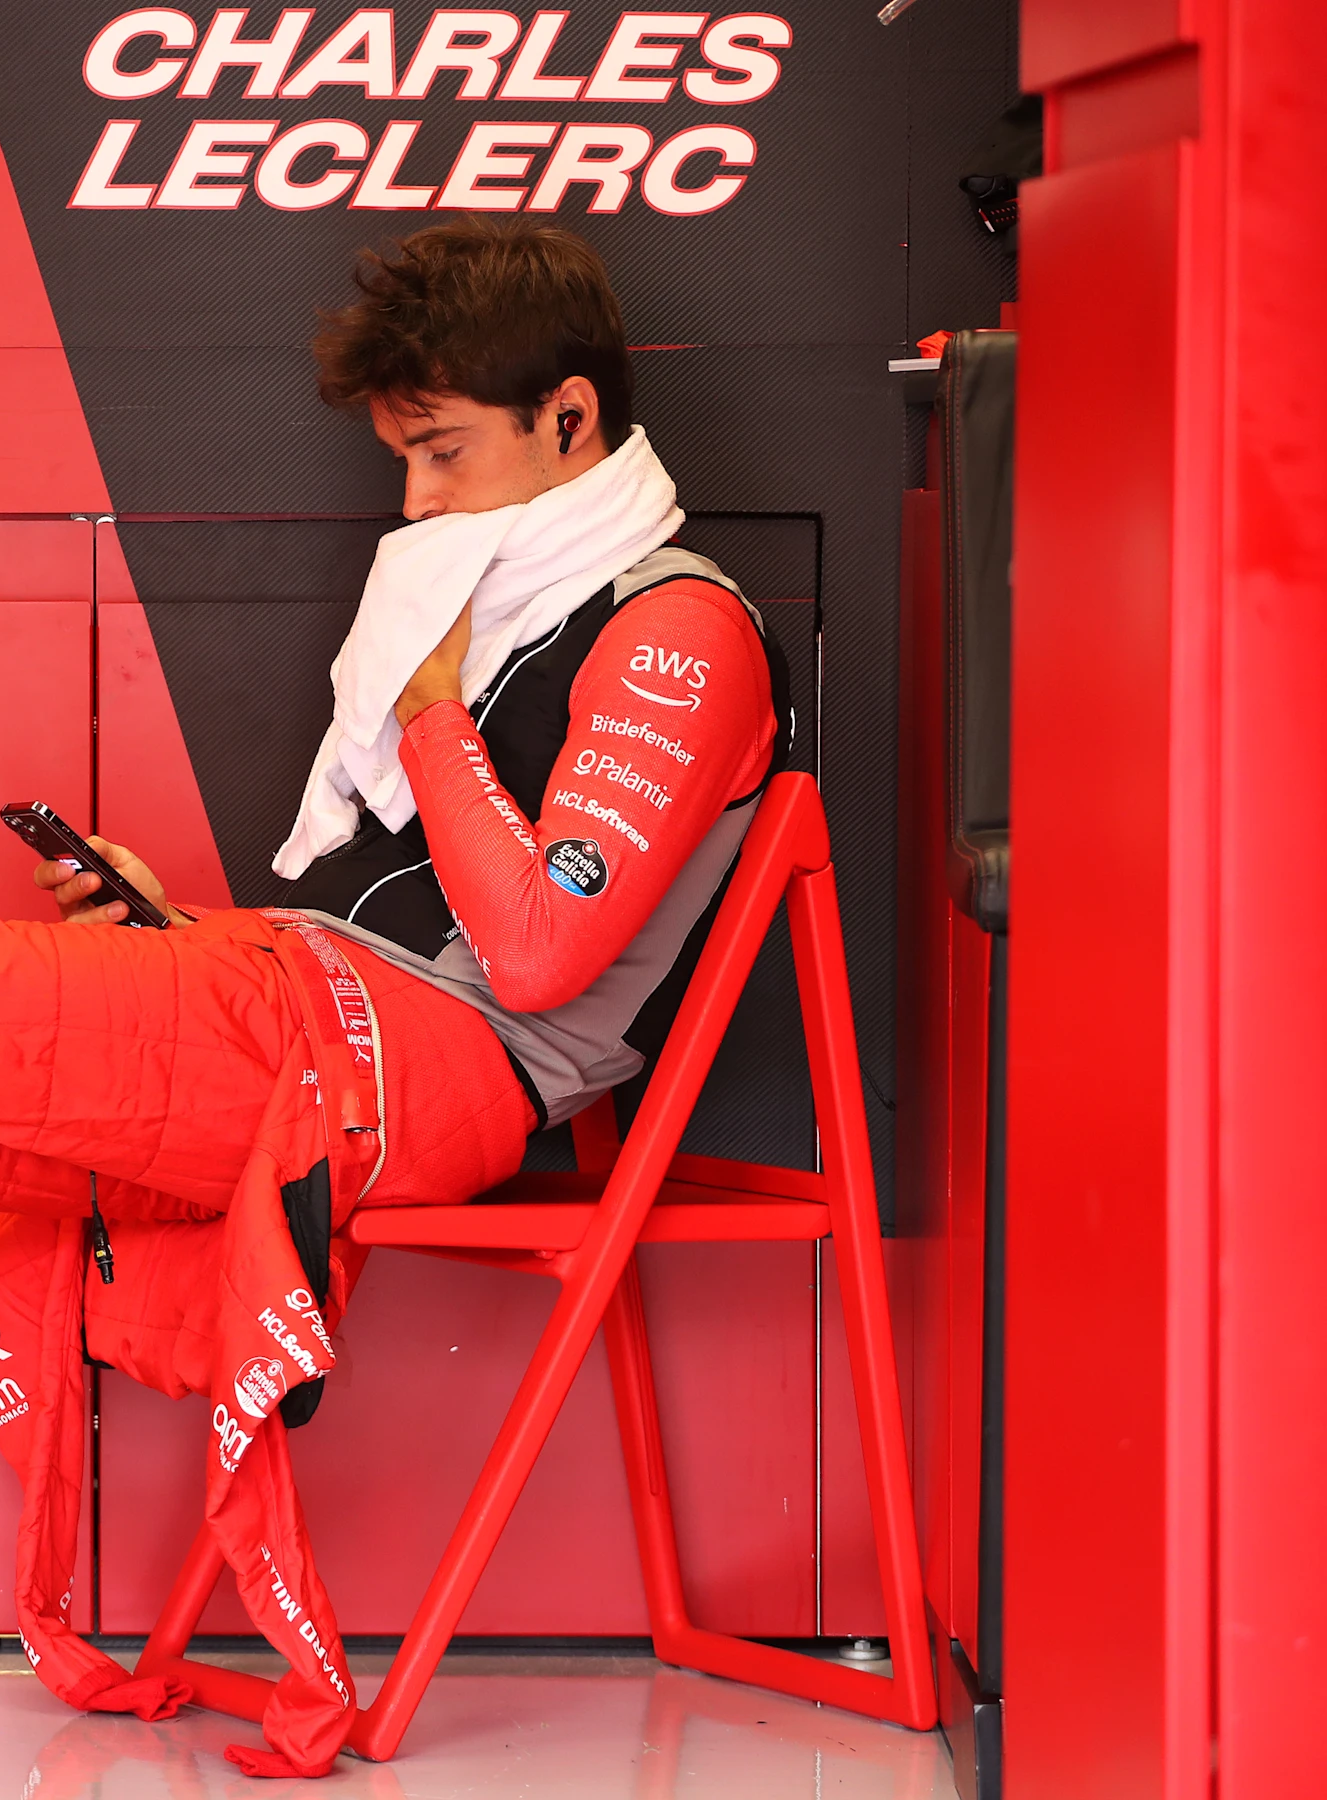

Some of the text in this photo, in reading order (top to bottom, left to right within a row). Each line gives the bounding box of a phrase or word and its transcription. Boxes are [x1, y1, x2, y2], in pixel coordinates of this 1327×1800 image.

[82, 6, 793, 105] CHARLES
[66, 119, 756, 216] LECLERC
[629, 644, 711, 689] aws
[591, 713, 696, 767] Bitdefender
[594, 754, 673, 811] Palantir
[552, 789, 651, 853] HCLSoftware
[551, 853, 590, 888] Galicia
[558, 843, 601, 880] Estrella
[241, 1374, 269, 1408] Galicia
[248, 1363, 280, 1399] Estrella
